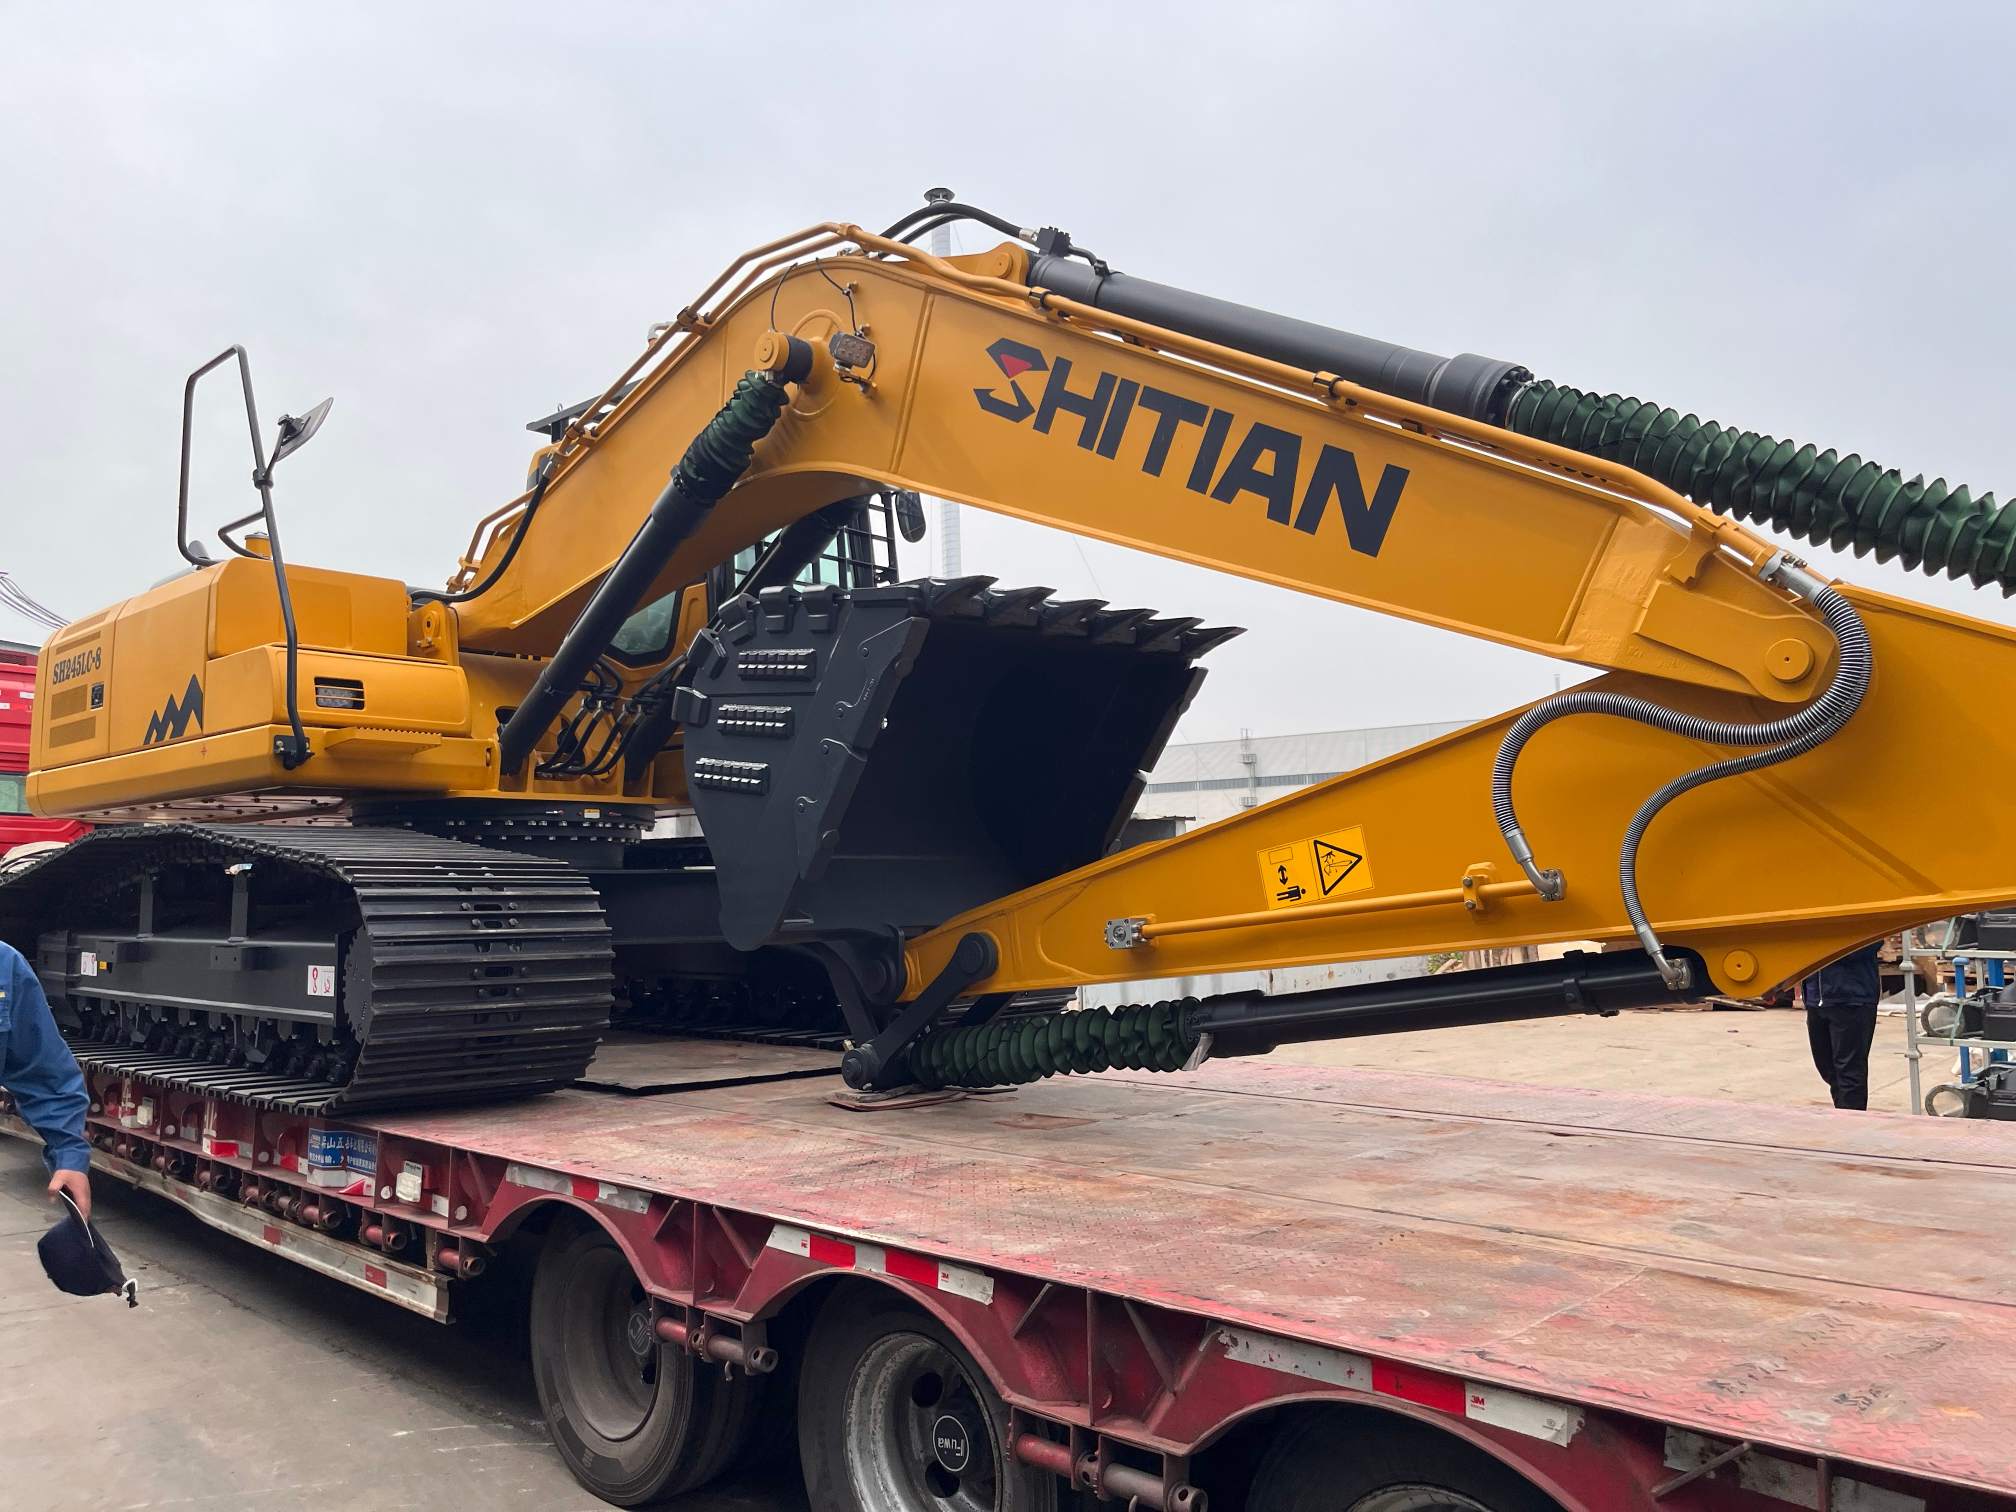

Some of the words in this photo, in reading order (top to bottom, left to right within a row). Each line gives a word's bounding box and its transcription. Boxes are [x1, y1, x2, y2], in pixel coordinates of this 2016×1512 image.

[973, 337, 1411, 558] SHITIAN
[53, 646, 102, 685] SH245LC-8
[1471, 1395, 1485, 1405] 3M
[937, 1437, 965, 1457] Fuwa
